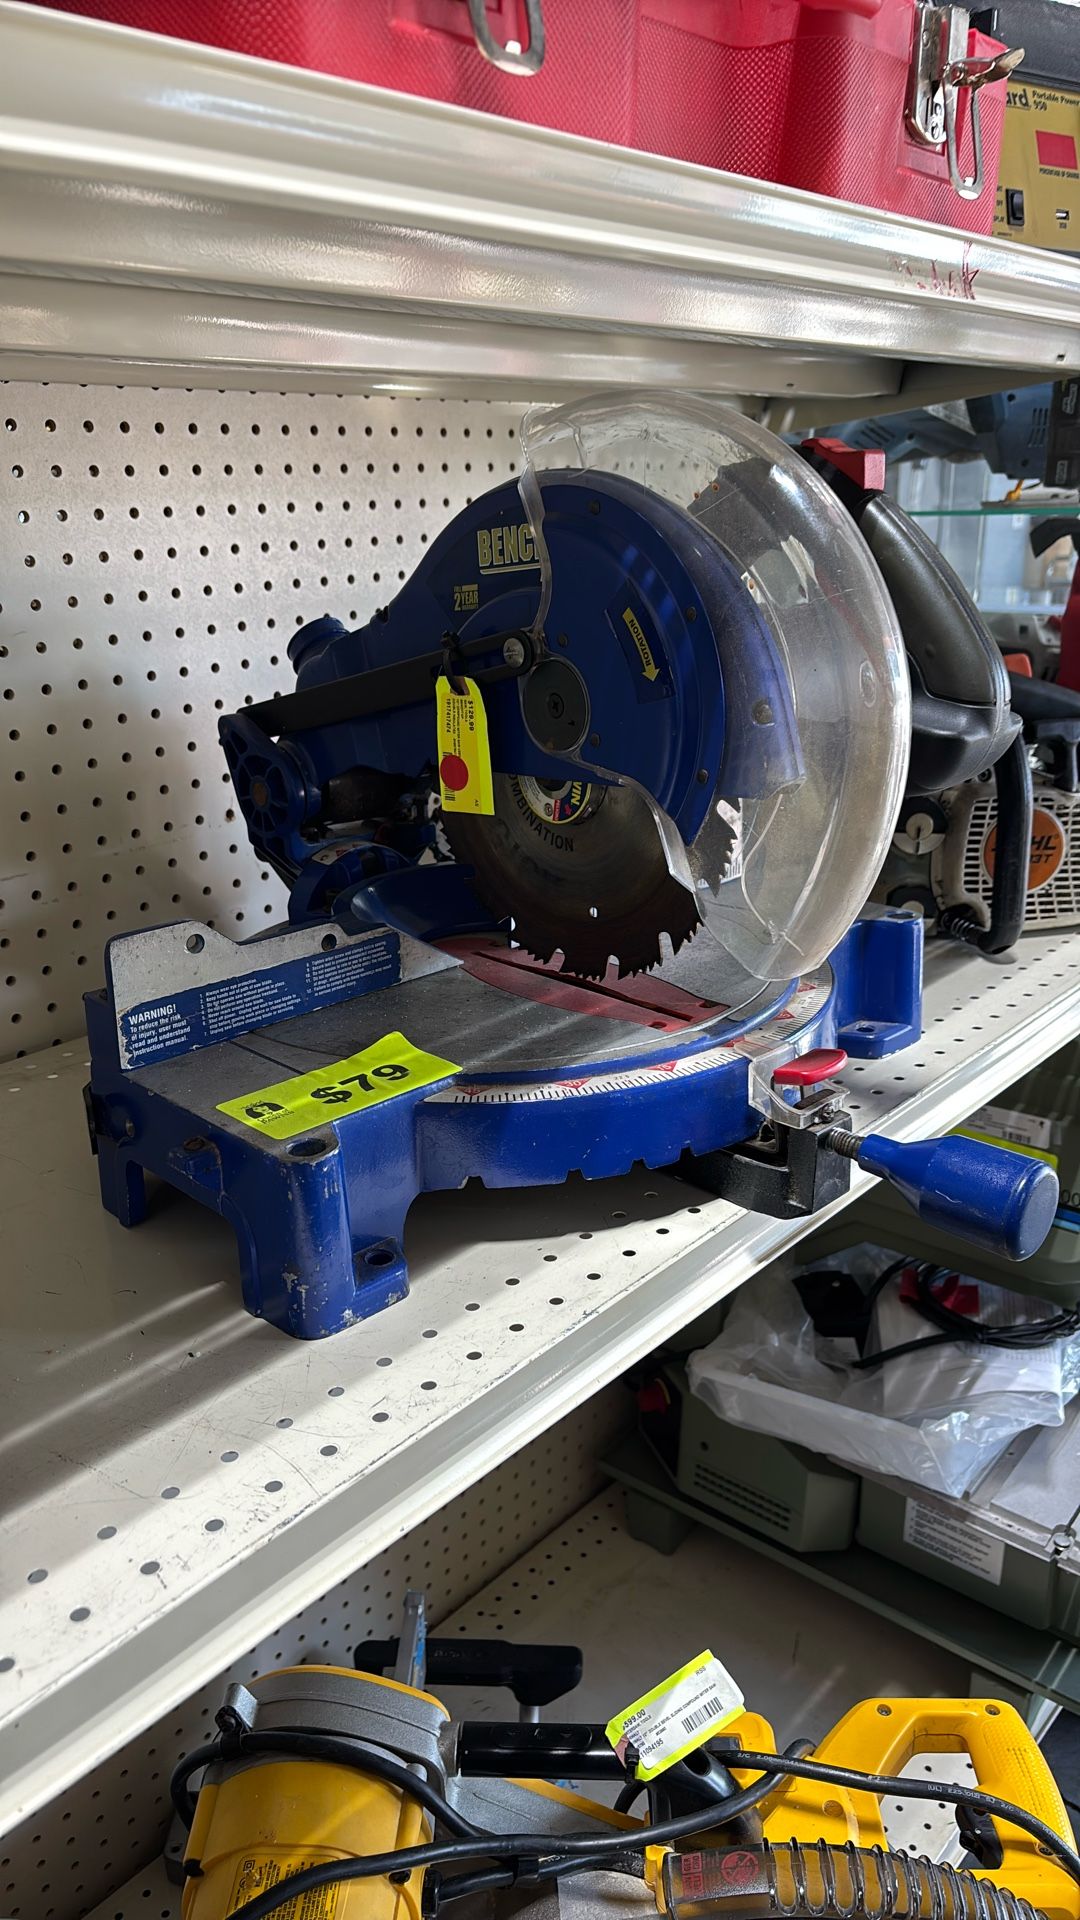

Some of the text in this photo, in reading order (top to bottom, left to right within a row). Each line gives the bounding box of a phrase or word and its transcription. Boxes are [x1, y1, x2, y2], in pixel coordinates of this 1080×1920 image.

[1006, 88, 1030, 108] ard
[1032, 90, 1058, 104] Portable
[454, 591, 479, 611] 2 YEAR
[628, 619, 652, 667] ROTATION
[508, 774, 575, 852] OMBINATION
[128, 1005, 173, 1024] WARNING!
[138, 1021, 158, 1031] reduce
[170, 1013, 181, 1021] risk
[172, 1019, 187, 1028] must
[132, 1026, 191, 1048] read and understand
[165, 1035, 187, 1046] manual.
[310, 1063, 411, 1105] $79
[670, 1707, 683, 1718] SLIDING
[682, 1695, 700, 1709] COMPOUND
[699, 1688, 709, 1696] MITER
